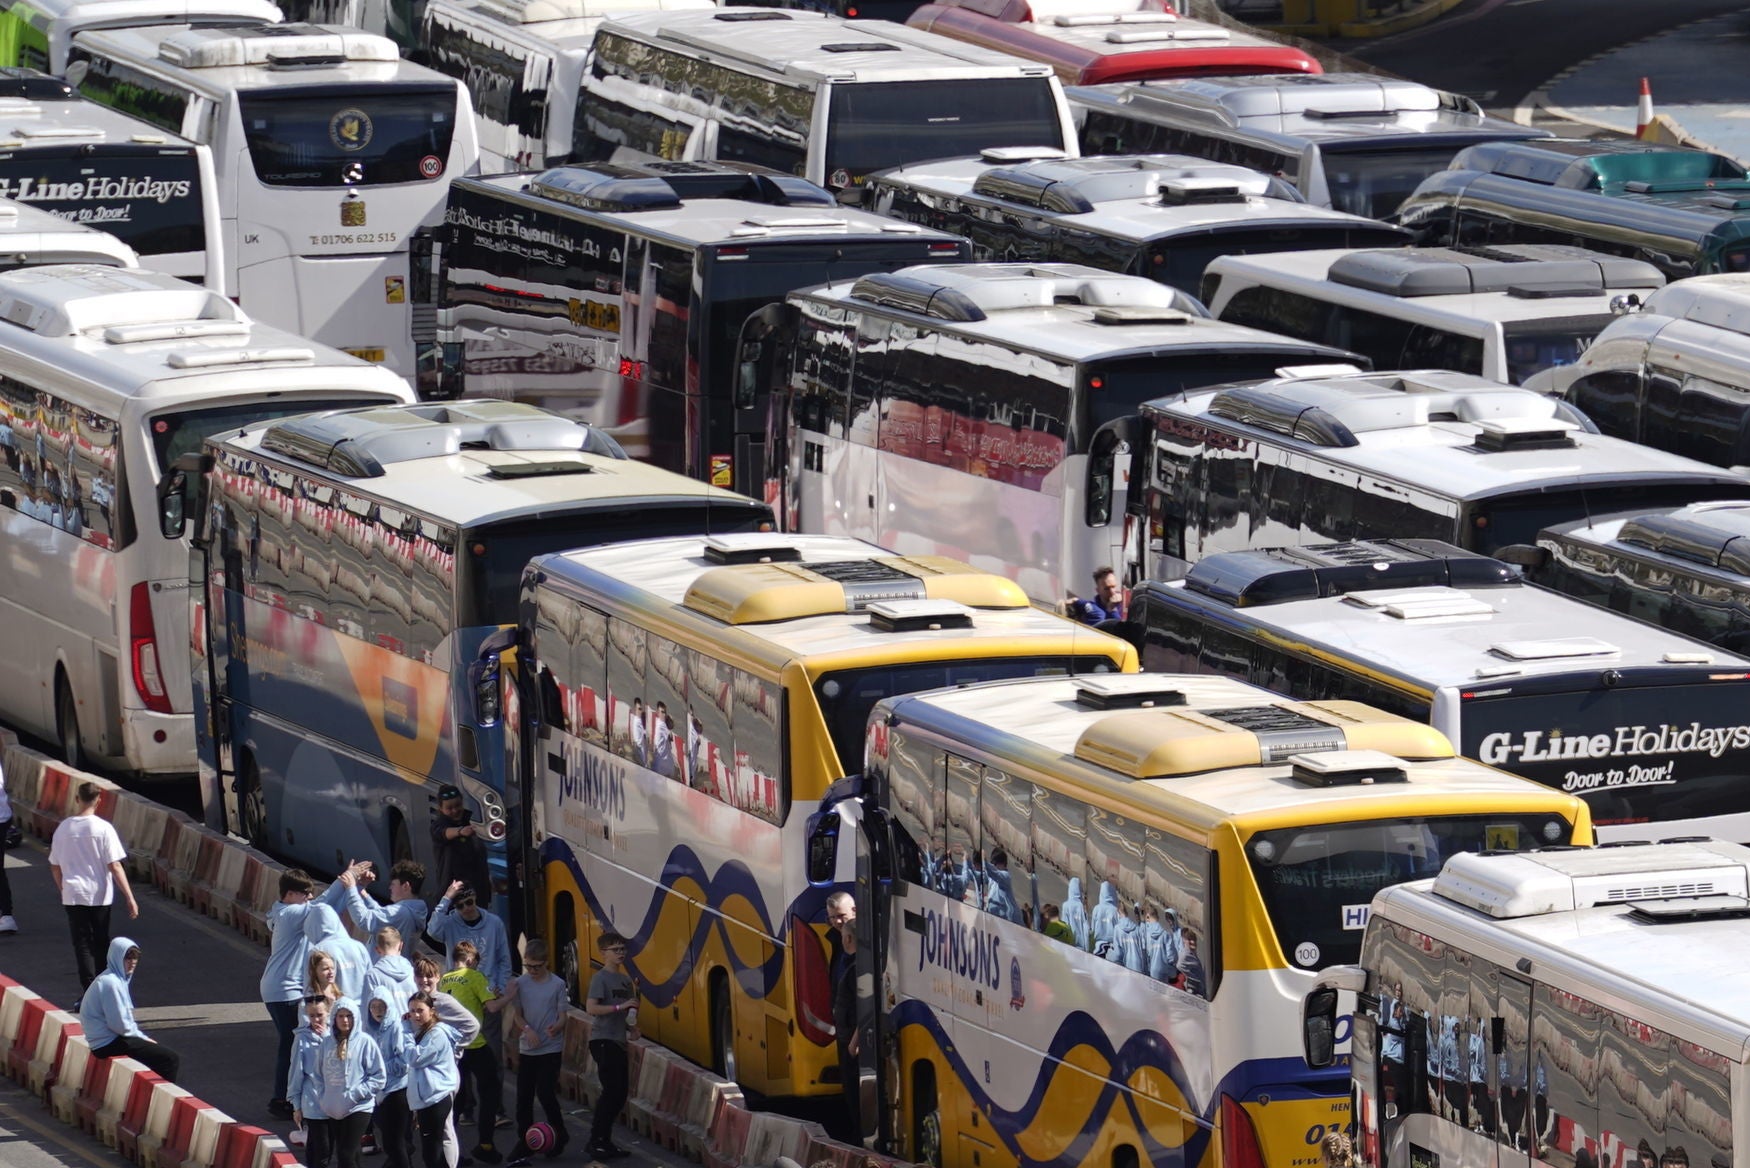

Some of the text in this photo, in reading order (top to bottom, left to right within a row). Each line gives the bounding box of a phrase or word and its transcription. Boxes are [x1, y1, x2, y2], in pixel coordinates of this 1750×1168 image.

[424, 161, 438, 171] 100
[83, 176, 191, 203] Holidays
[244, 234, 259, 244] UK
[321, 235, 353, 245] 01706
[356, 234, 375, 243] 622
[377, 233, 397, 242] 515
[1479, 728, 1612, 764] G-Line
[559, 741, 626, 821] JOHNSONS
[1562, 760, 1675, 791] Door to Door!
[919, 907, 1000, 990] JOHNSONS
[1298, 949, 1318, 960] 100
